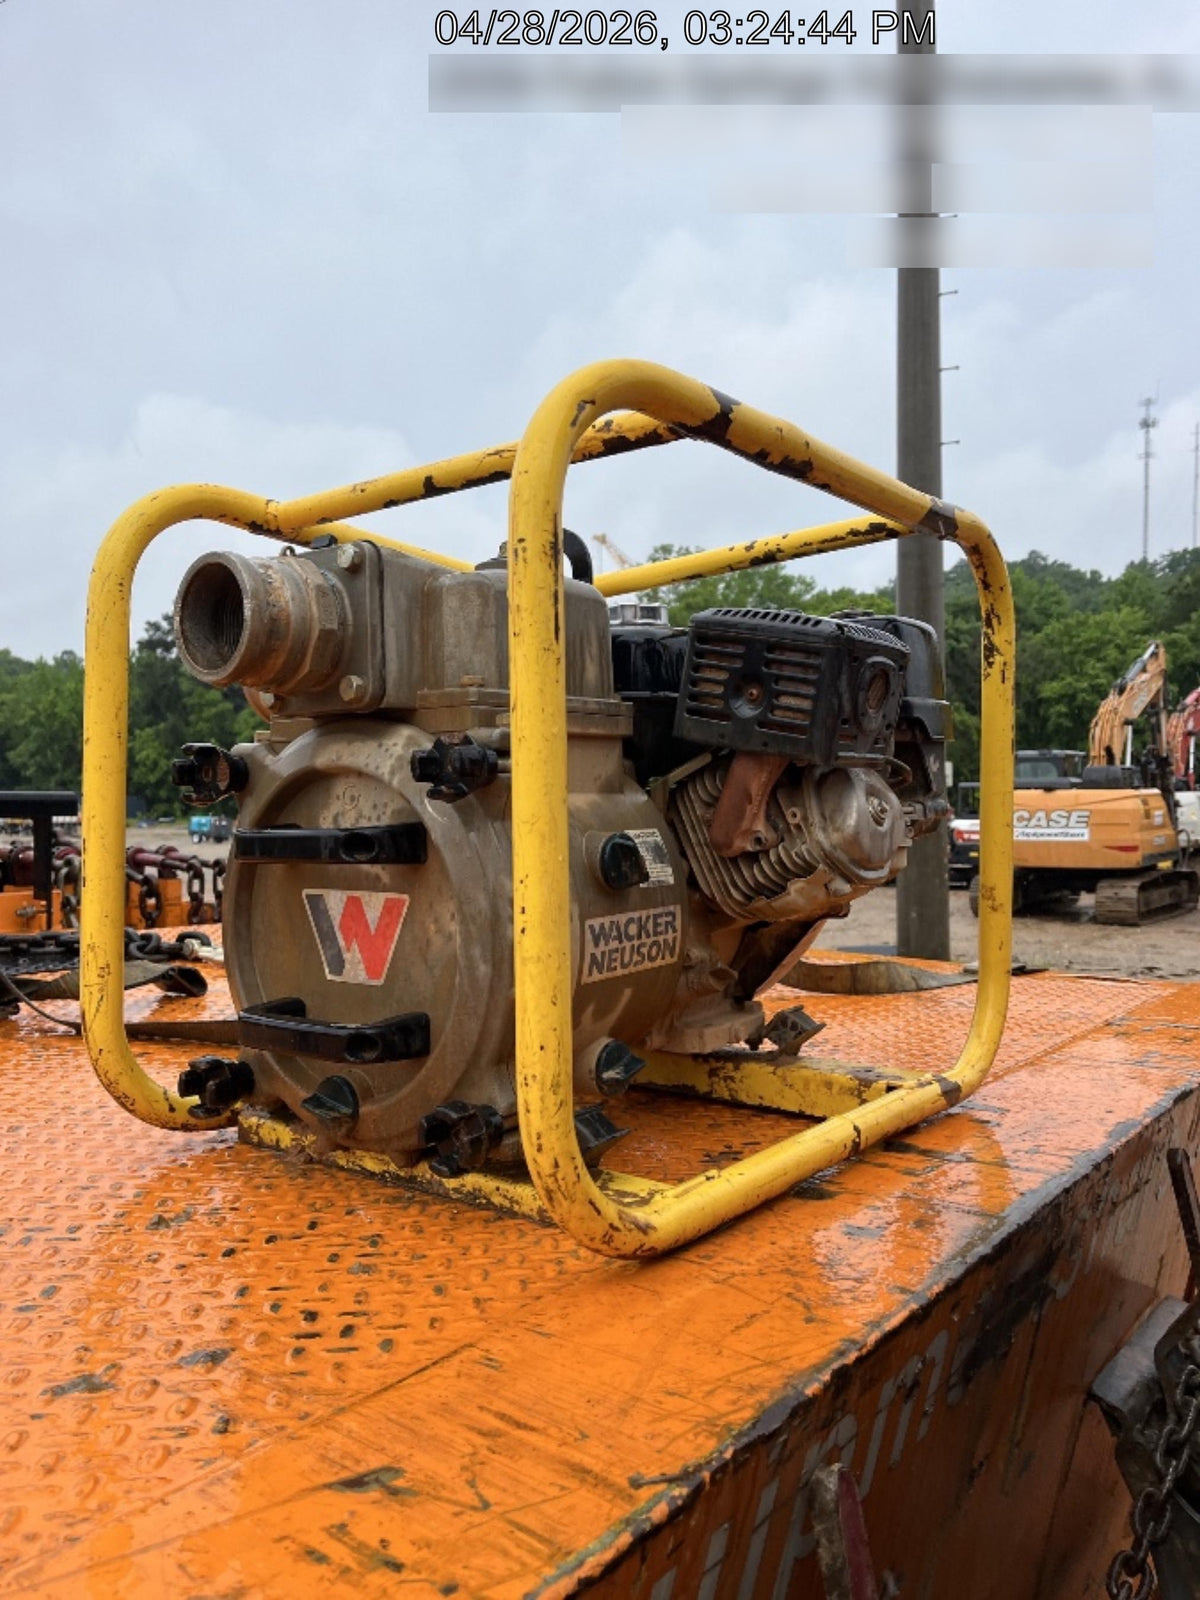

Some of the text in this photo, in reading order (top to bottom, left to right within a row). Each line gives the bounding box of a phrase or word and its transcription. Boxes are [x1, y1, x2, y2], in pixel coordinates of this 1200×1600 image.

[1013, 809, 1090, 828] CASE
[588, 910, 678, 949] WACKER
[587, 936, 678, 977] NEUSON
